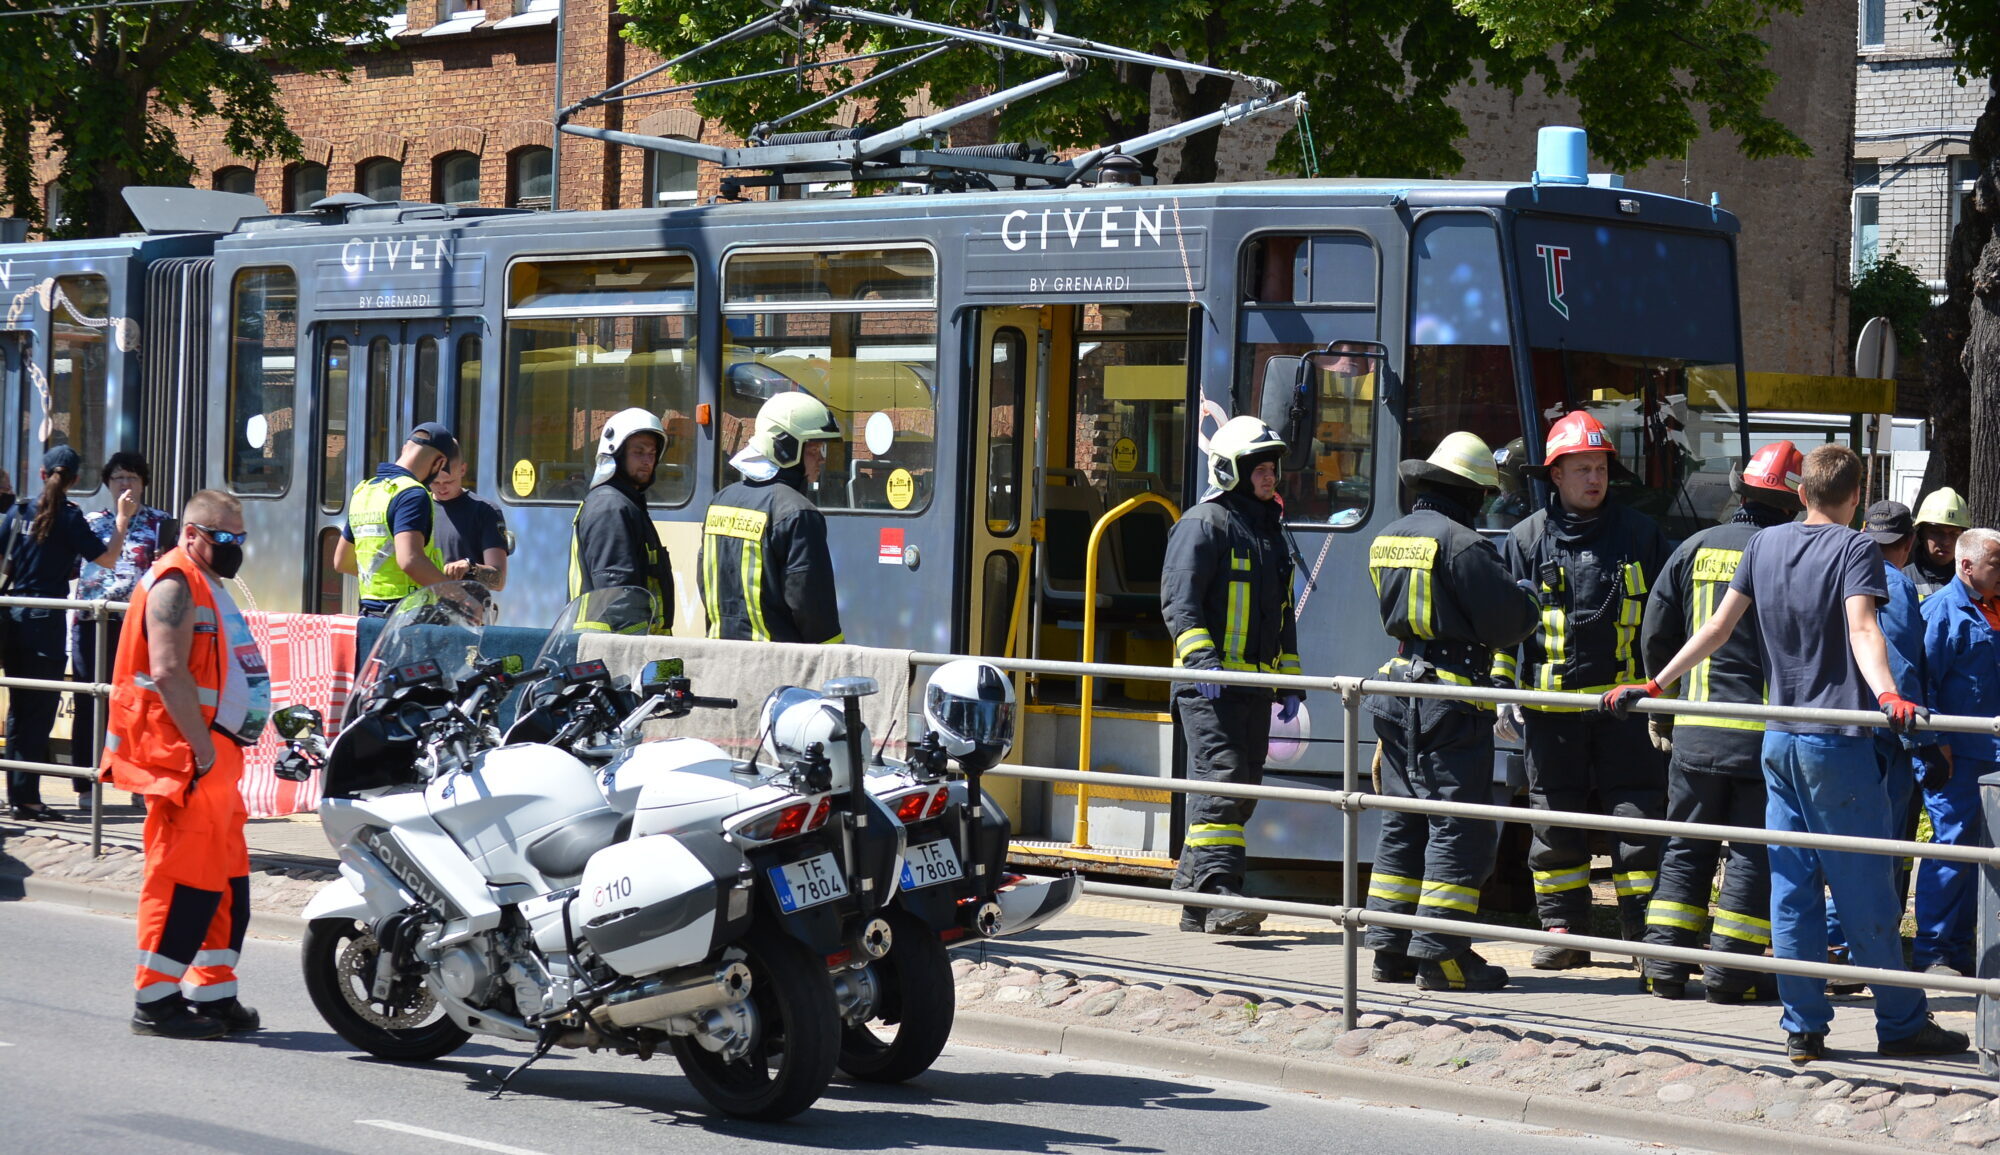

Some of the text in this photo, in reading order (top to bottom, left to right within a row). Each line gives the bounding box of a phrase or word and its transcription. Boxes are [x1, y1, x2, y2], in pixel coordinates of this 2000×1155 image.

[1001, 204, 1165, 251] GIVEN
[341, 233, 459, 273] GIVEN
[1029, 275, 1131, 292] BY GRENARDI
[359, 294, 431, 308] BY GRENARDI
[917, 843, 940, 863] TF
[367, 832, 447, 917] POLICIJA
[798, 858, 822, 881] TF
[915, 859, 957, 883] 7808
[605, 876, 632, 902] 110
[780, 875, 841, 905] LV 7804
